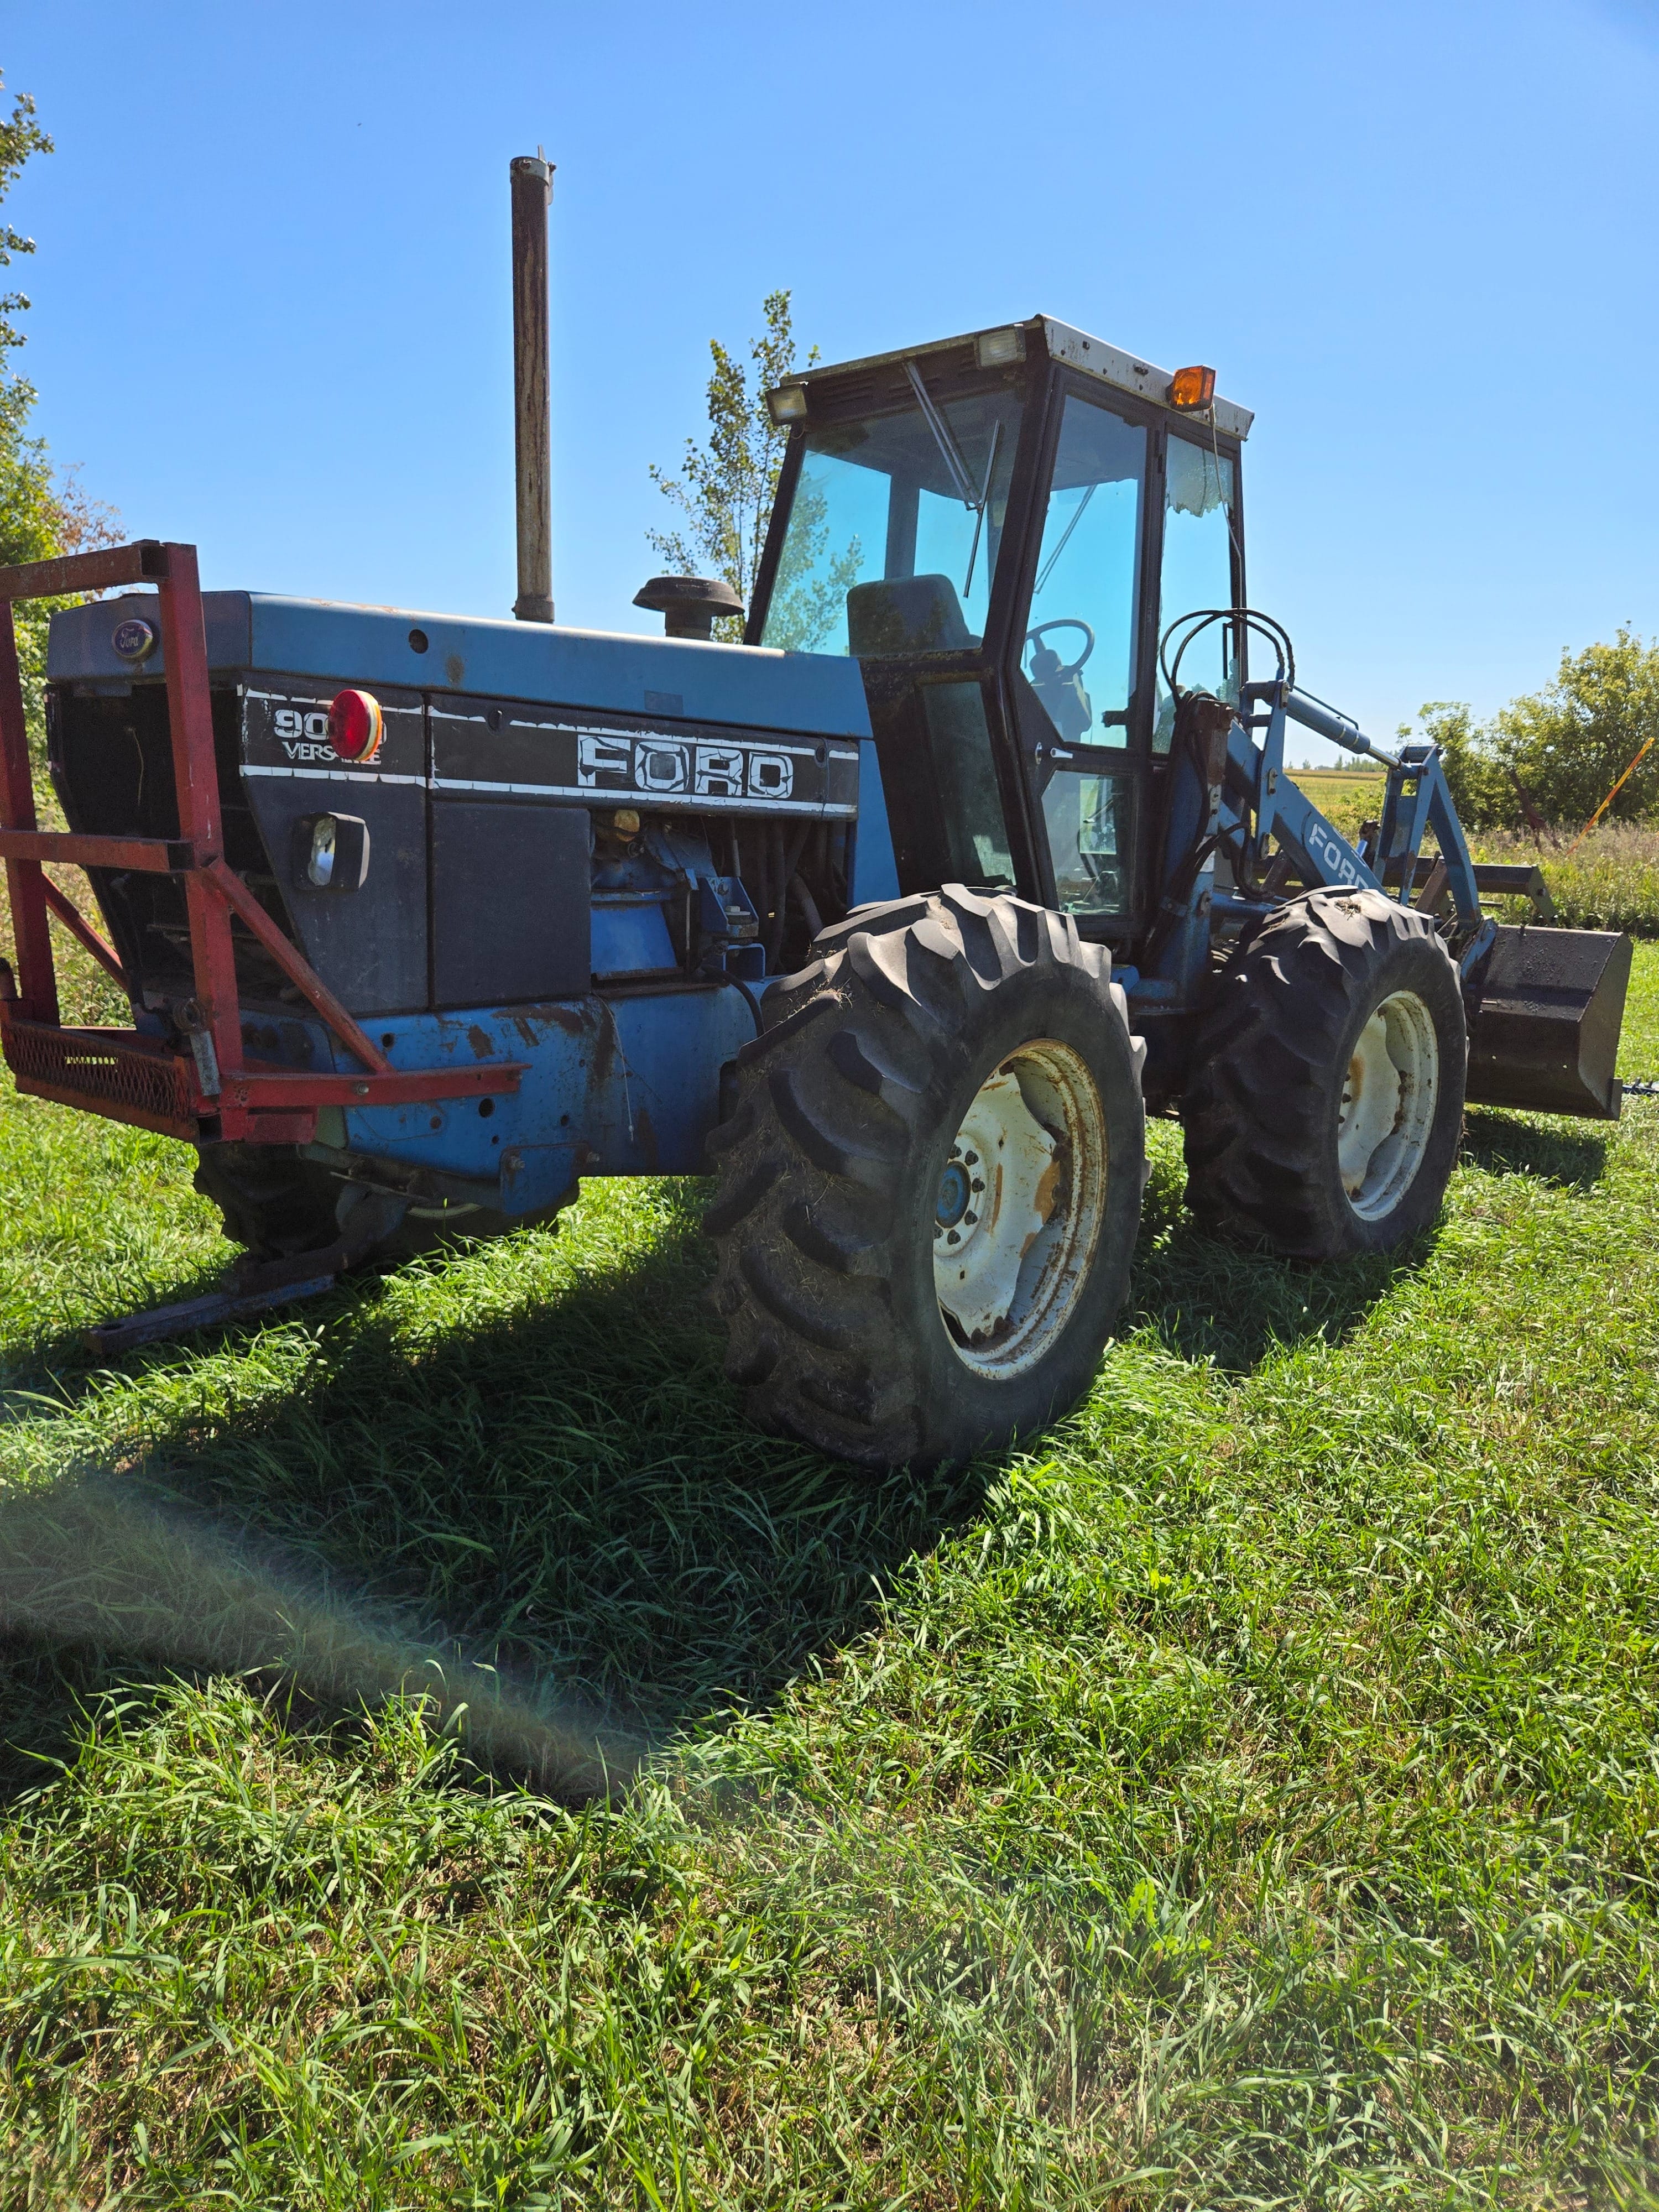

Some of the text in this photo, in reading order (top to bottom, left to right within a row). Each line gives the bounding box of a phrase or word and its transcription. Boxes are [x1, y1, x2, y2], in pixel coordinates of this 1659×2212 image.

[120, 628, 138, 648] Ford
[274, 709, 387, 745] 90
[577, 734, 794, 799] FORD
